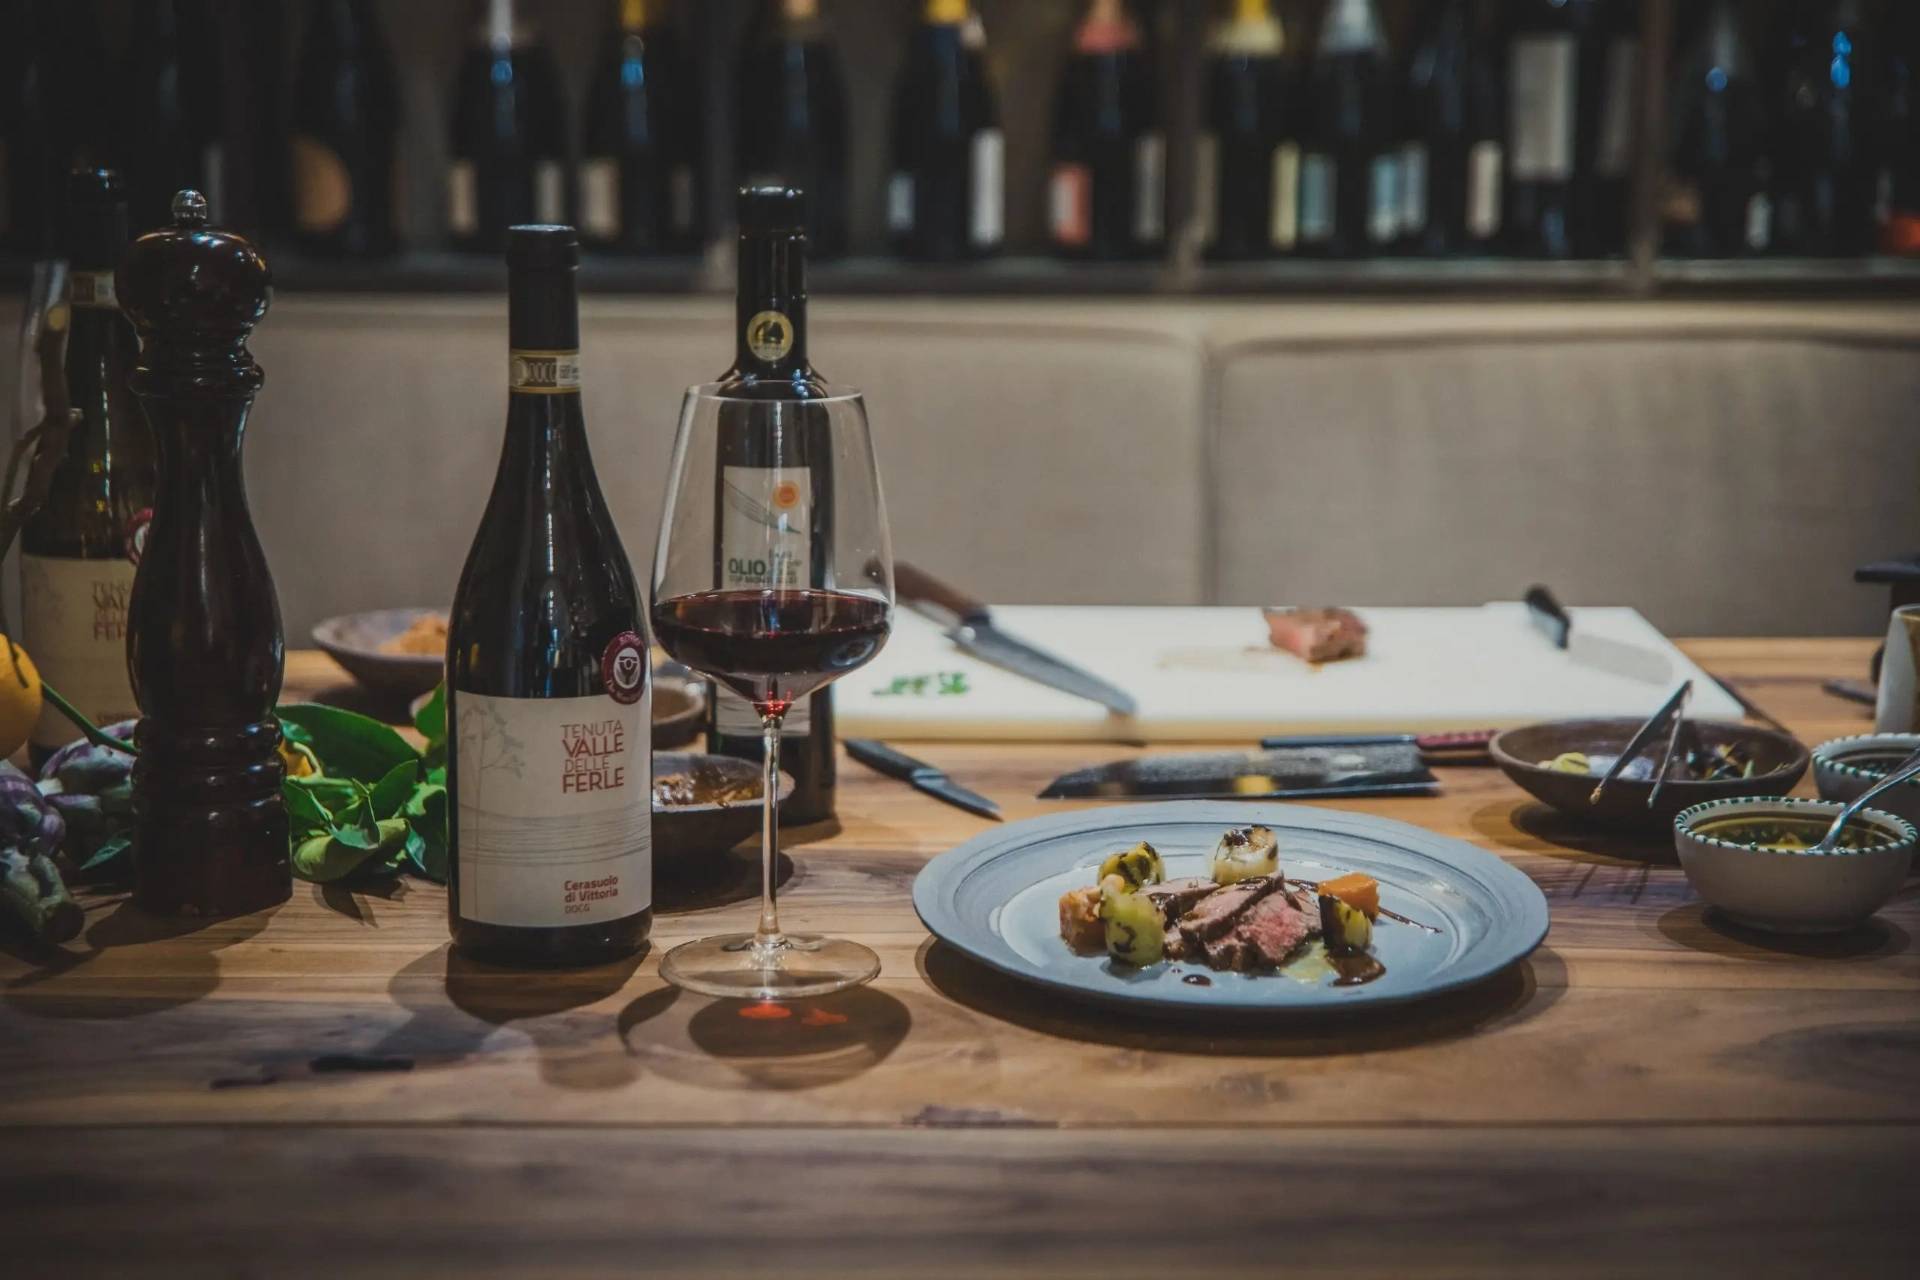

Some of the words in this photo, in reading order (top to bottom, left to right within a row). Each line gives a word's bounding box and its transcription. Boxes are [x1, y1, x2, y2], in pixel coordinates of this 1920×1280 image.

[728, 558, 766, 576] OLIO
[560, 720, 623, 739] TENUTA
[562, 733, 625, 758] VALLE
[565, 755, 609, 773] DELLE
[562, 767, 625, 794] FERLE
[564, 875, 618, 892] Cerasuolo
[564, 891, 576, 903] di
[579, 887, 618, 902] Vittoria
